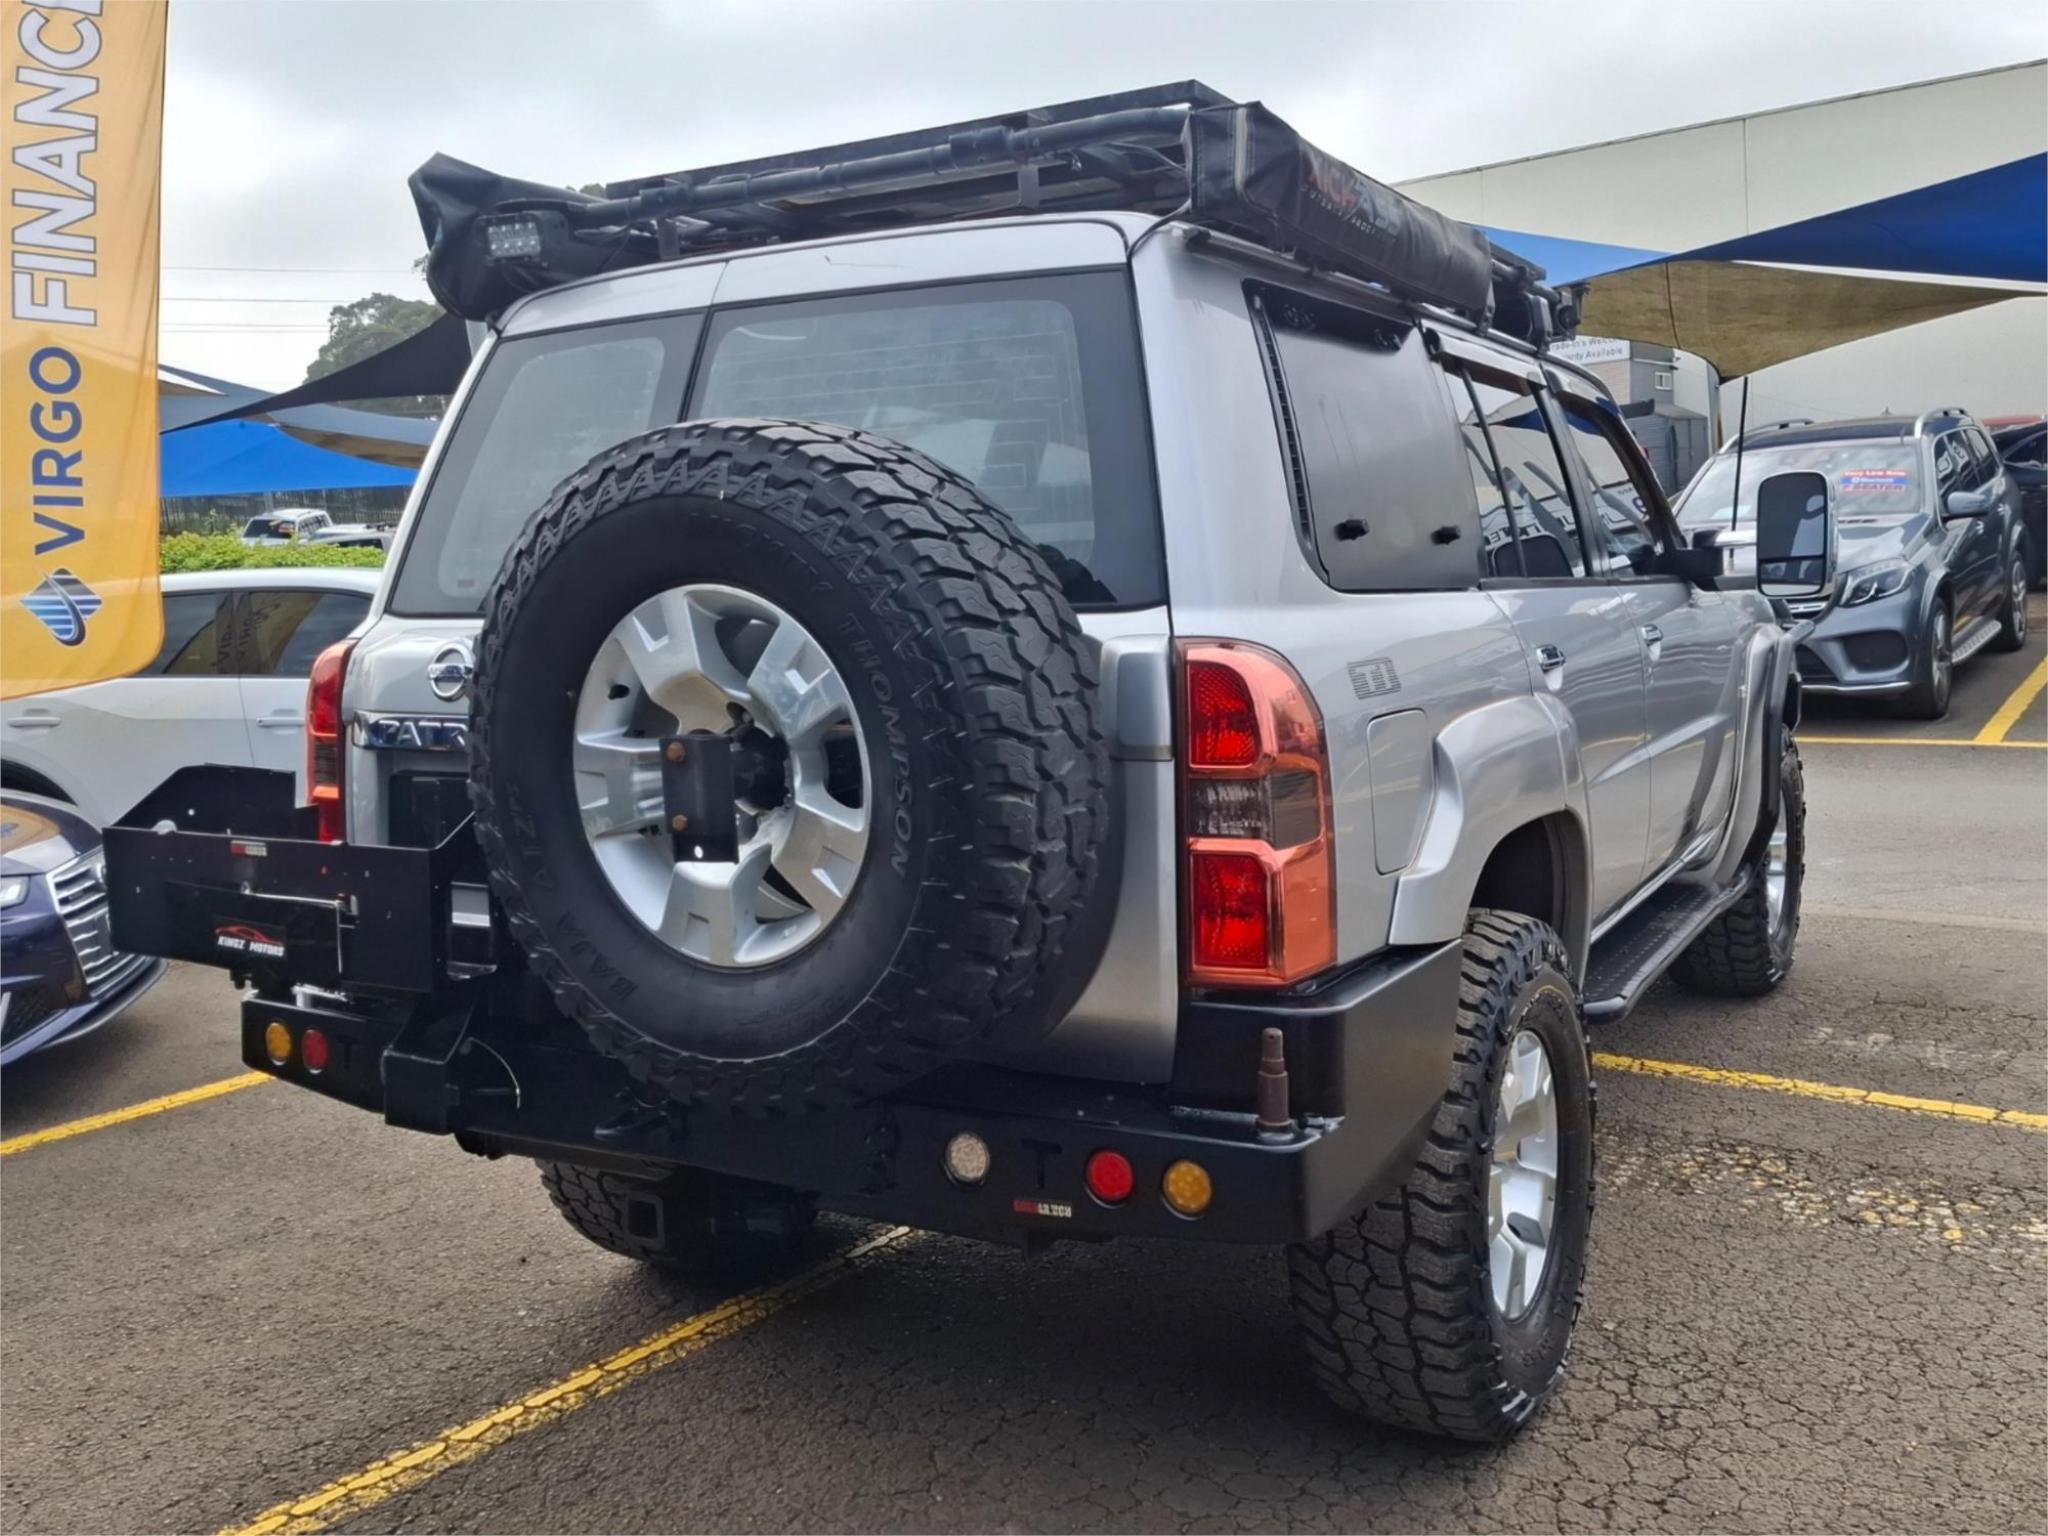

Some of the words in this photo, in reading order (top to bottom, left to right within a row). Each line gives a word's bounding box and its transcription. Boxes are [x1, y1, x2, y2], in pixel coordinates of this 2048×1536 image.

[28, 346, 86, 556] VIRGO
[374, 719, 469, 747] PATR
[837, 612, 914, 878] THOMPSON
